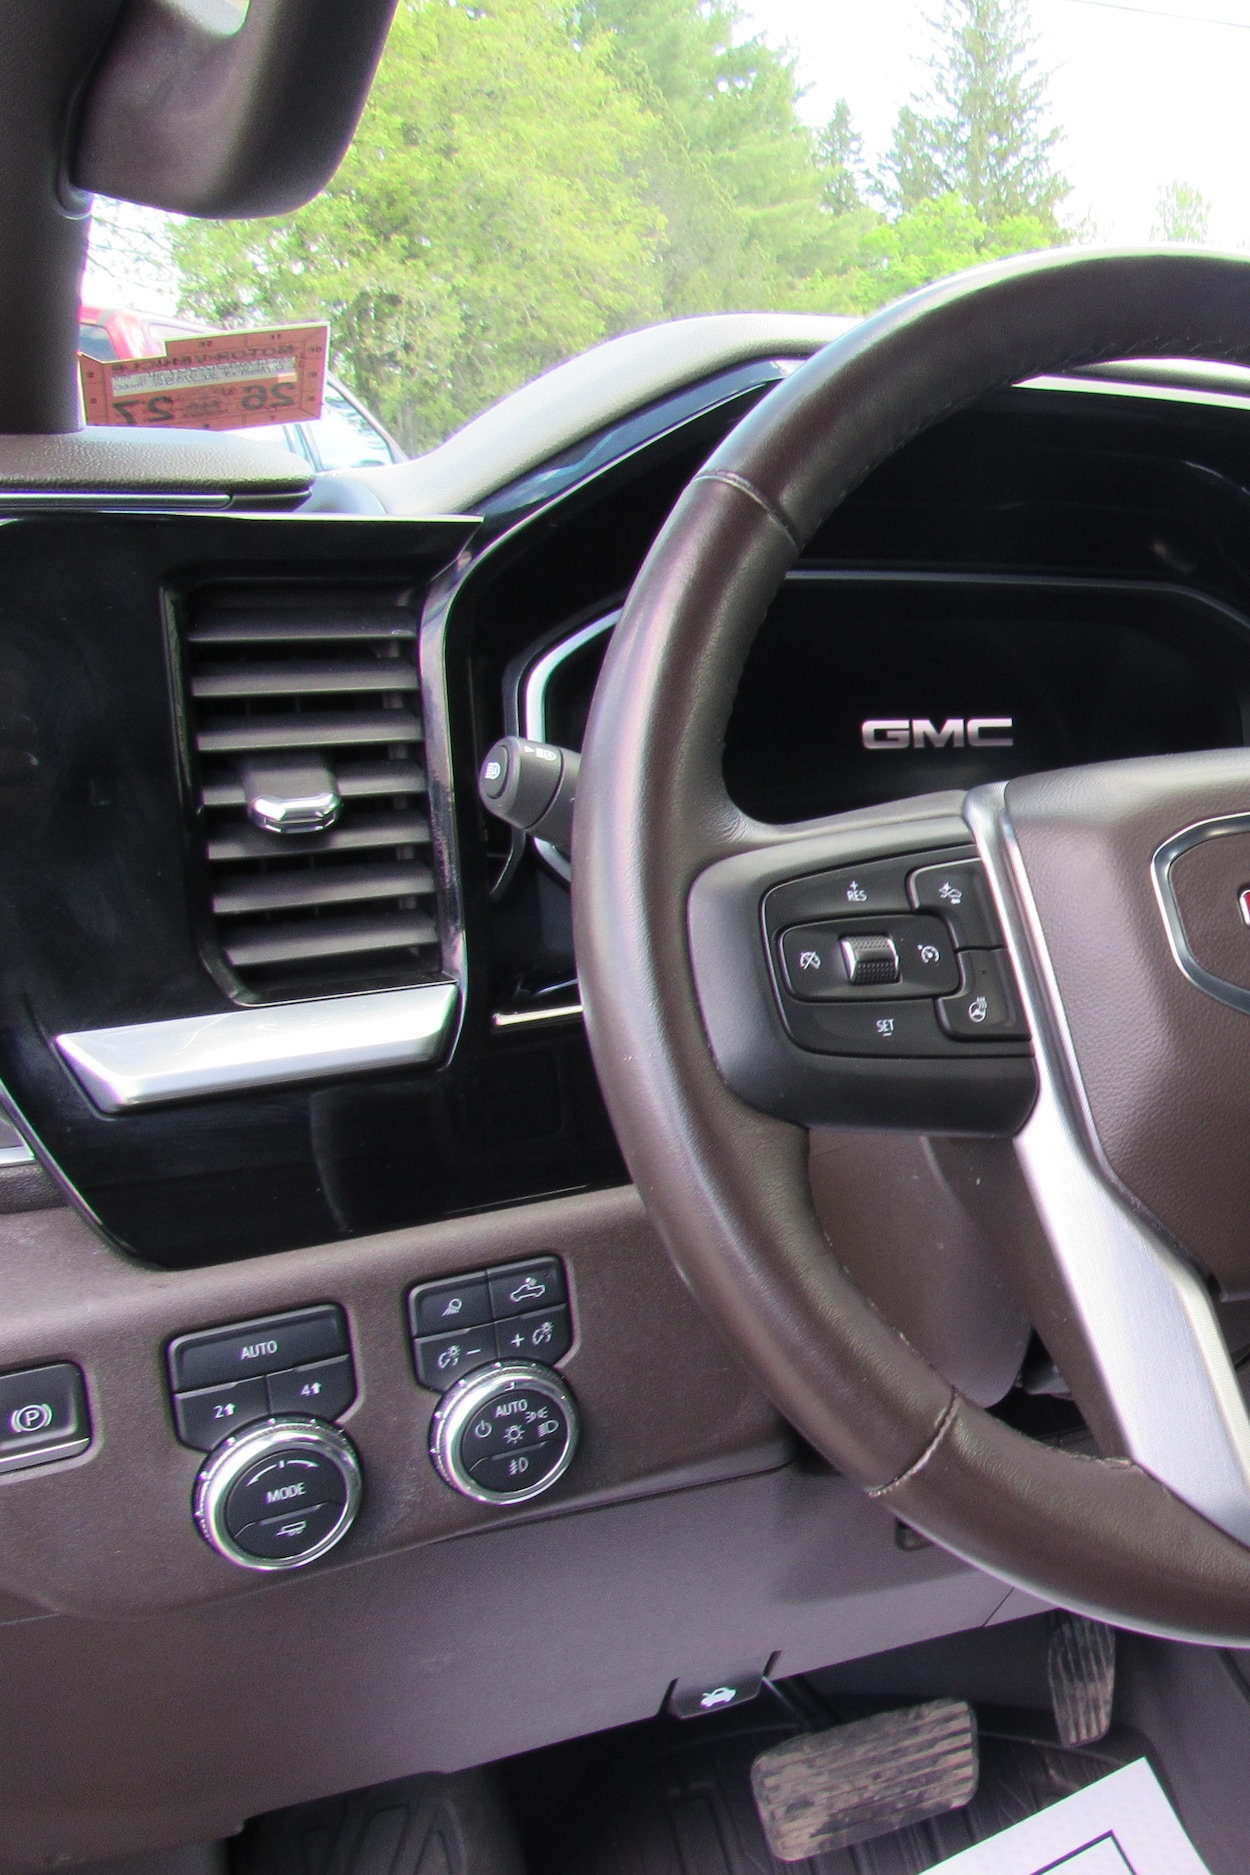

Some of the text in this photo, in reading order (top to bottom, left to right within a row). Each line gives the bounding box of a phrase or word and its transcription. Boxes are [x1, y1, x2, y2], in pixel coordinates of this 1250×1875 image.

[861, 718, 1014, 749] GMC
[847, 889, 868, 902] RES
[876, 1018, 895, 1033] SET
[240, 1340, 278, 1360] AUTO
[494, 1399, 528, 1418] AUTO
[266, 1481, 306, 1504] MODE
